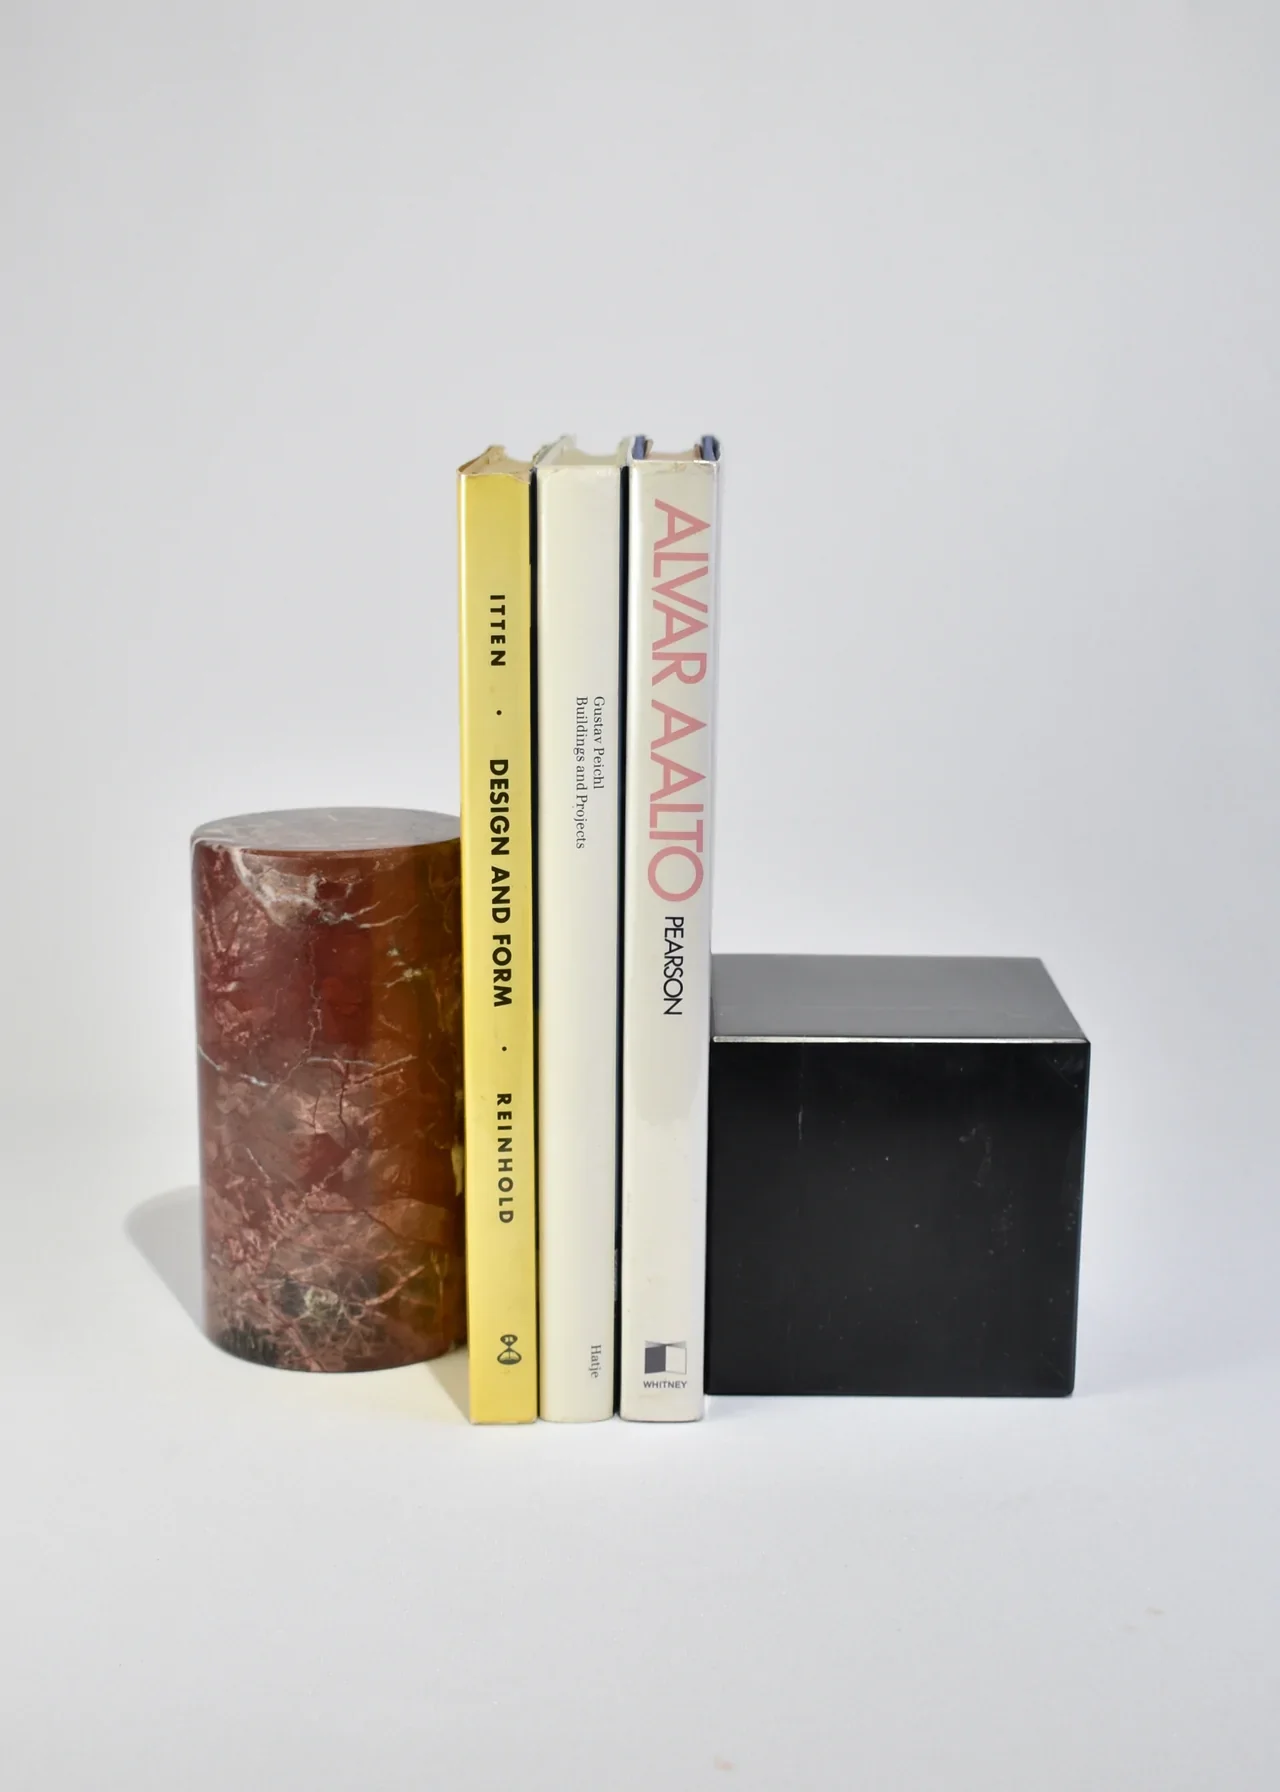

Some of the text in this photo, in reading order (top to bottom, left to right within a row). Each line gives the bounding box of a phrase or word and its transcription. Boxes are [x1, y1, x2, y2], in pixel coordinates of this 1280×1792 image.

[490, 595, 506, 666] ITTEN
[593, 696, 606, 789] Gustav Peichl
[647, 499, 711, 903] ALVAR AALTO
[573, 696, 588, 849] Buildings and Projects
[489, 759, 512, 1007] DESIGN AND FORM
[663, 916, 685, 1016] PEARSON
[496, 1092, 514, 1224] REINHOLD
[588, 1344, 602, 1379] Hatje
[643, 1380, 688, 1389] WHITNEY
